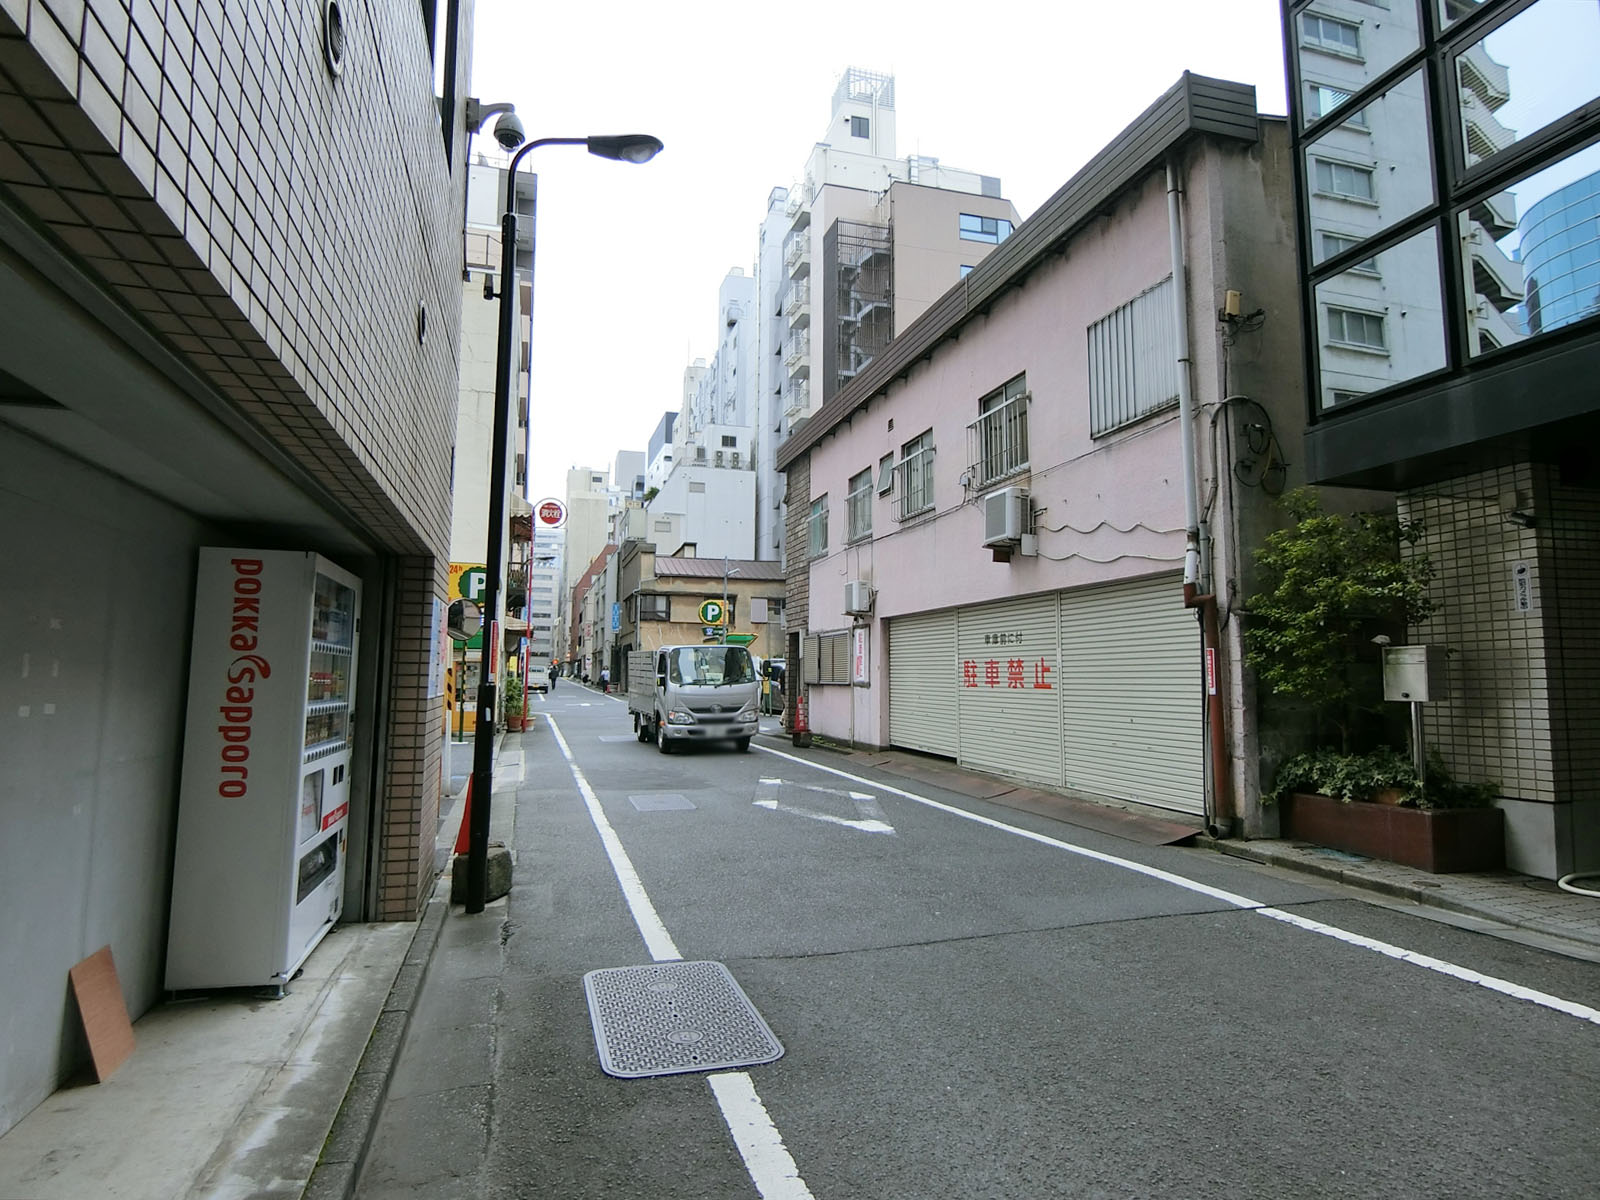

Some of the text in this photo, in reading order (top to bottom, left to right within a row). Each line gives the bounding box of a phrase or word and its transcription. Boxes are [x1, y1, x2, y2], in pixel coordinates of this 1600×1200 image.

[449, 564, 463, 575] 24h
[469, 572, 486, 599] P
[707, 604, 720, 621] P
[218, 558, 264, 799] pokka sapporo
[963, 657, 1052, 688] 駐車禁止
